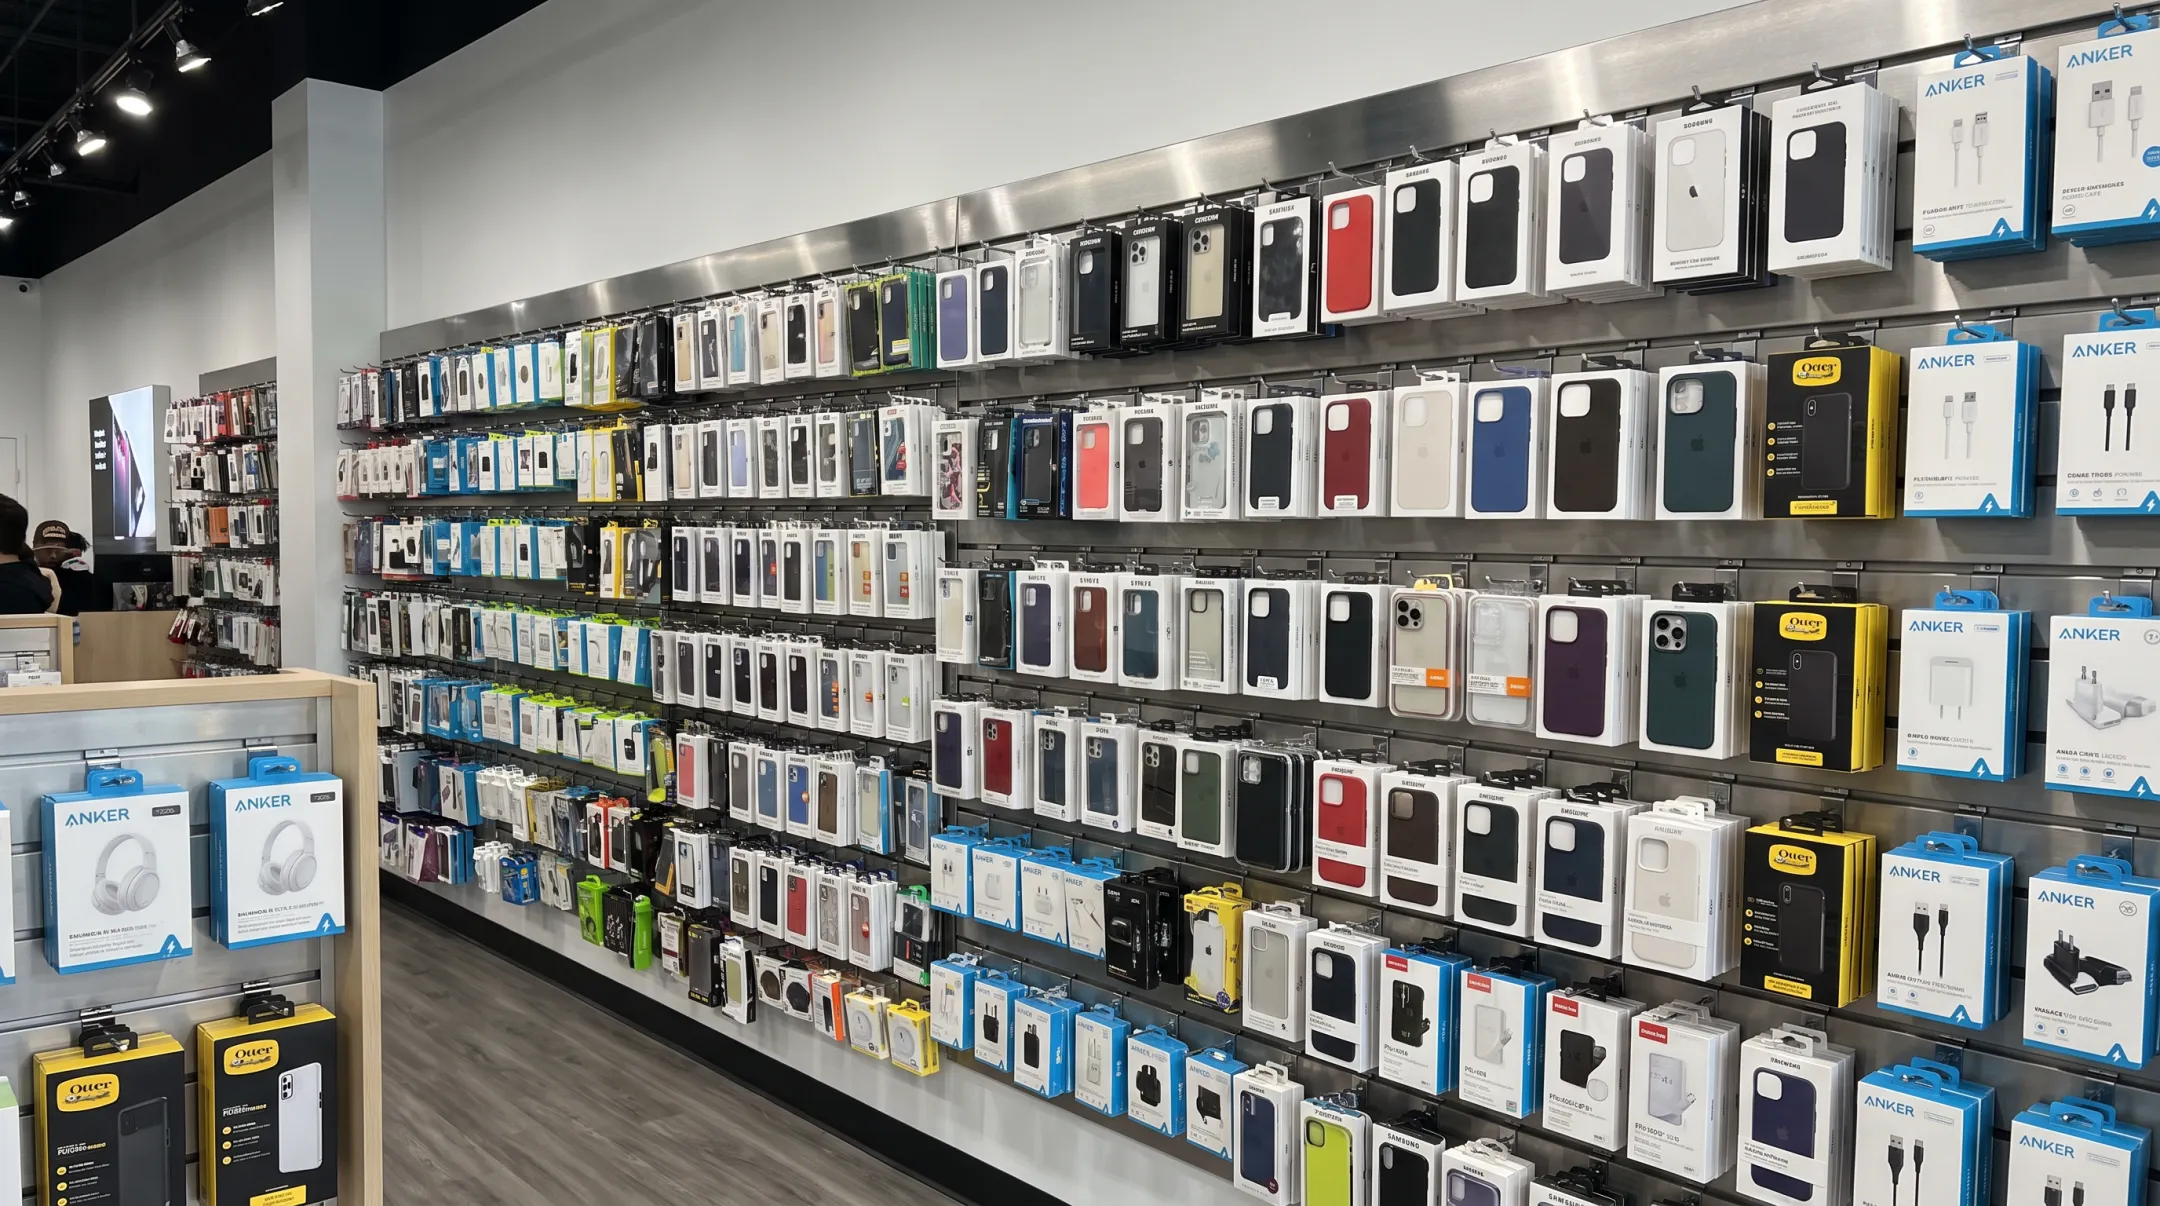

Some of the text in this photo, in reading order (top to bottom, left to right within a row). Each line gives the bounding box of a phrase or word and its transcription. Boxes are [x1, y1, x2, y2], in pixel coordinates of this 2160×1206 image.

[2066, 44, 2133, 68] ANKER
[1925, 74, 1985, 98] ANKER
[2072, 342, 2136, 358] ANKER
[1917, 354, 1975, 369] ANKER
[1909, 620, 1964, 633] ANKER
[2058, 628, 2120, 640] ANKER
[235, 794, 291, 812] ANKER
[65, 808, 130, 827] ANKER
[1889, 865, 1940, 884] ANKER
[2038, 890, 2095, 910] ANKER
[1864, 1096, 1914, 1117] ANKER
[2019, 1135, 2074, 1158] ANKER
